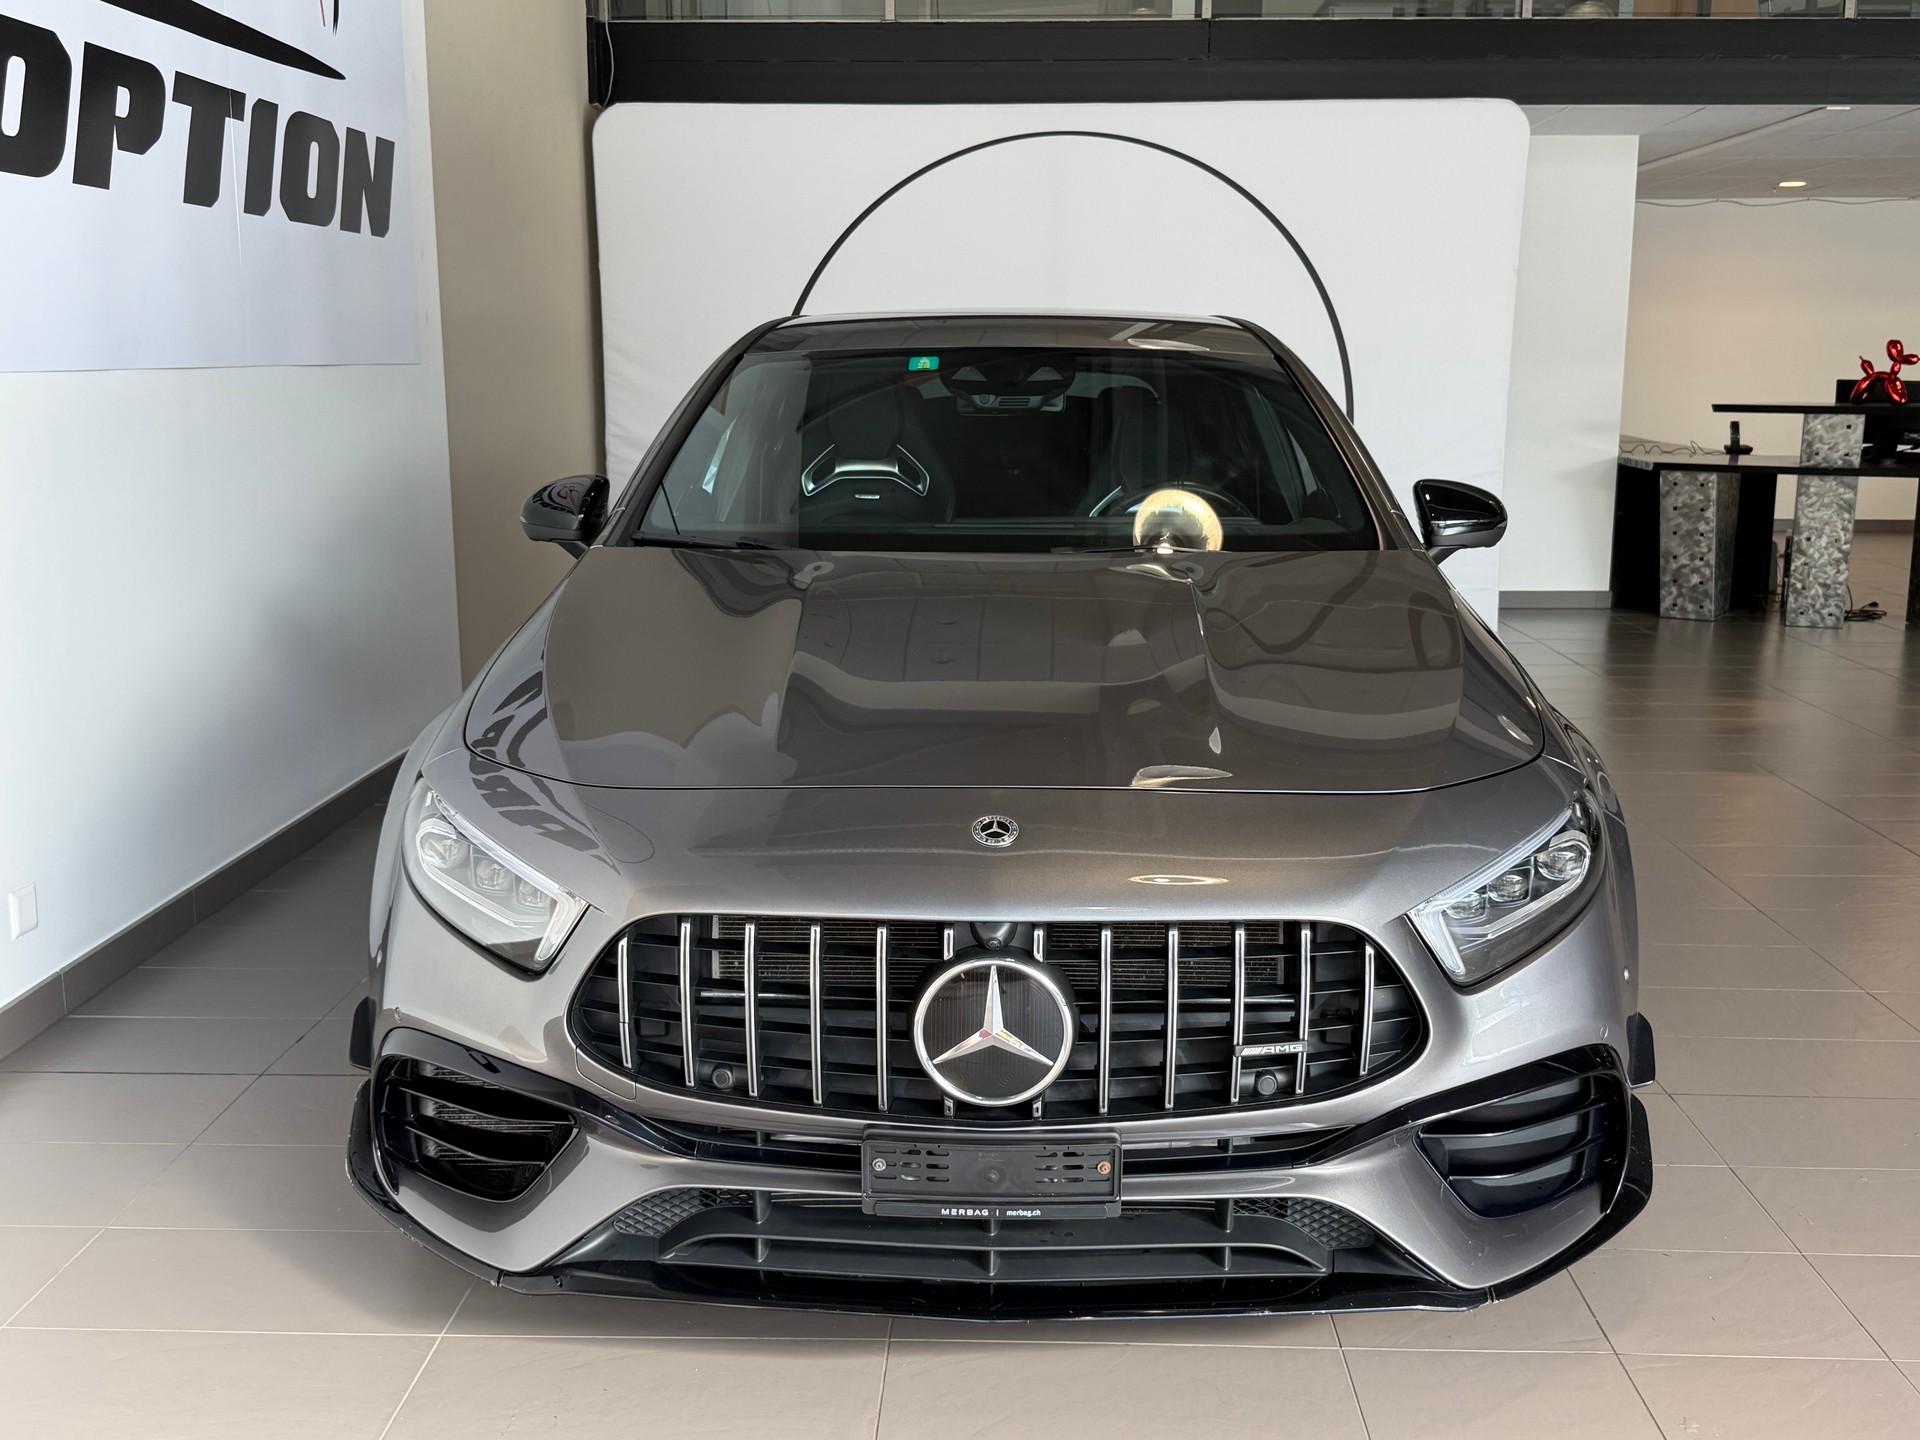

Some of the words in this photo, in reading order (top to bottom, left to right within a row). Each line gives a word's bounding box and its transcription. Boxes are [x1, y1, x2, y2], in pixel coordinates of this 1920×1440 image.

[0, 14, 395, 238] OPTION
[1261, 1044, 1303, 1054] AMG
[941, 1208, 989, 1216] MERBAG
[1006, 1209, 1041, 1217] merbag.ch
